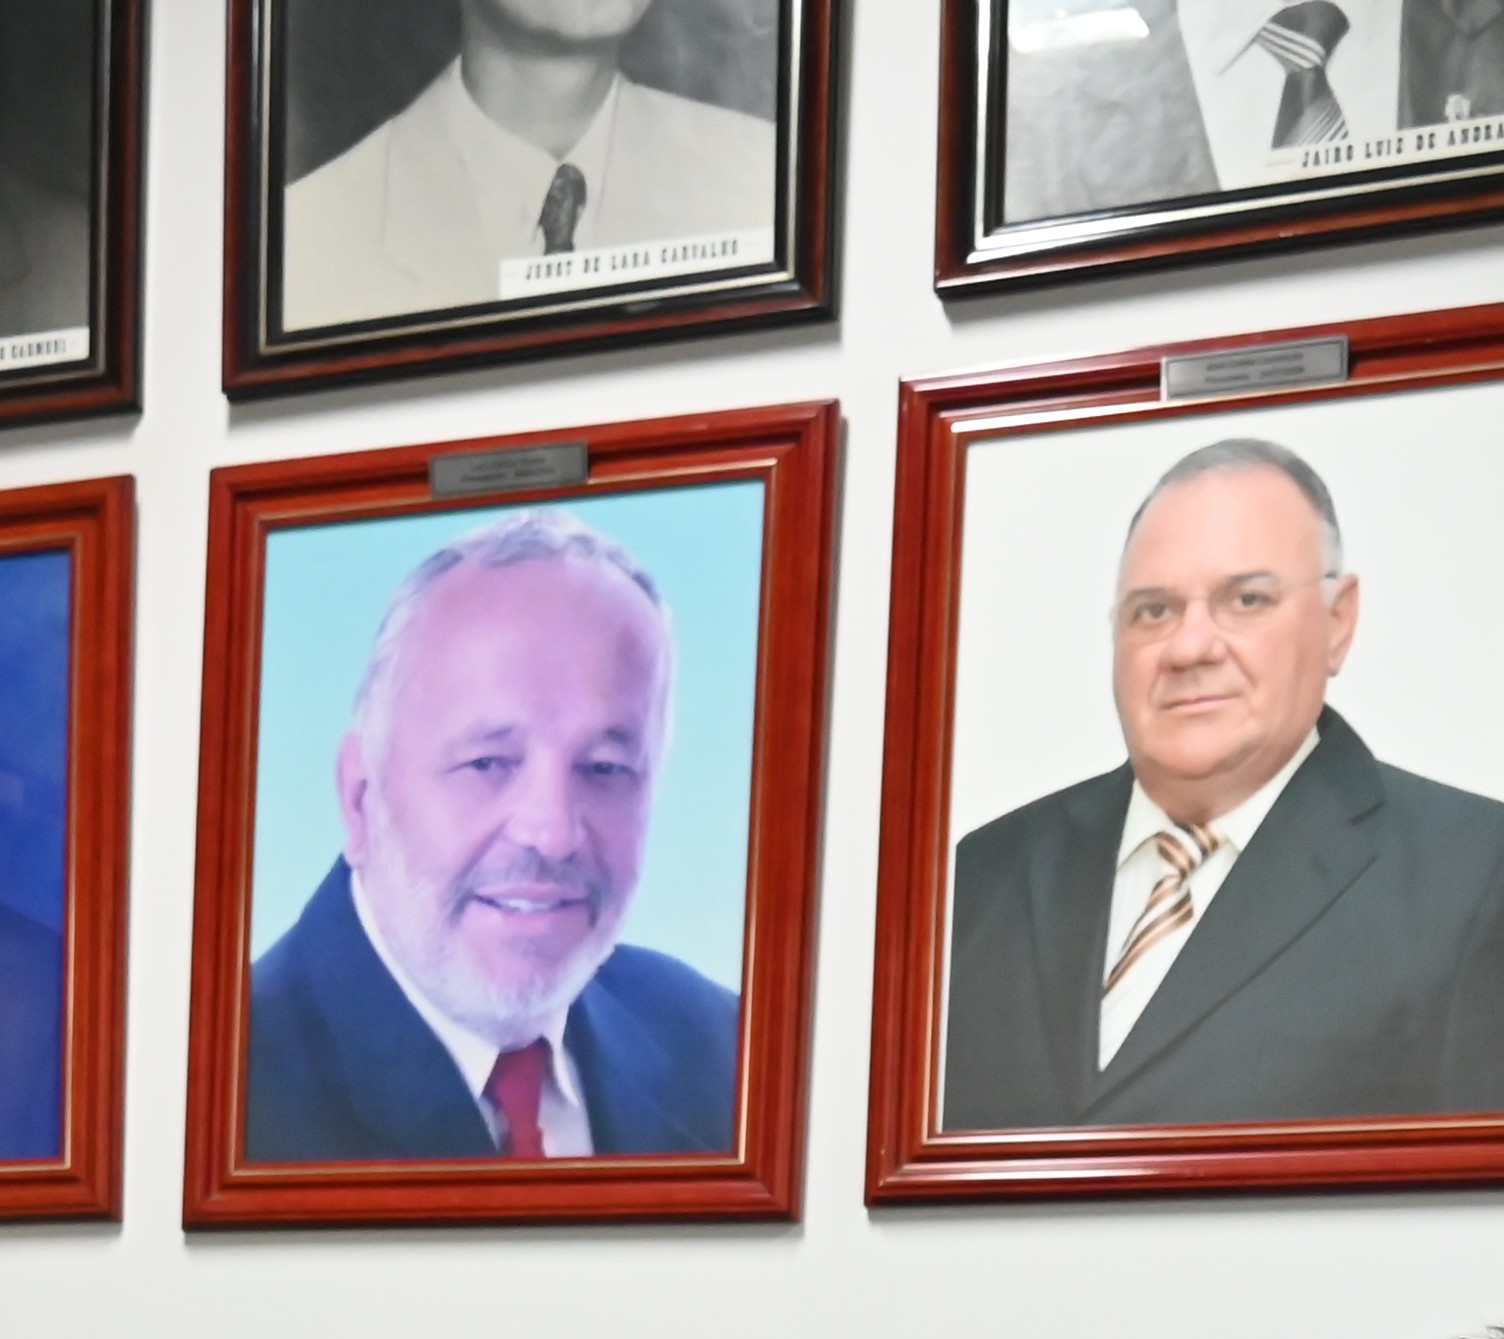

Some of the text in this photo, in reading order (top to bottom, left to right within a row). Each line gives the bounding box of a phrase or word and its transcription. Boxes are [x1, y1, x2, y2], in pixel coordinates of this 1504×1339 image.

[1302, 143, 1353, 167] JAIRO
[1365, 137, 1403, 160] LUIZ
[1416, 133, 1436, 151] DE
[584, 256, 601, 273] DE
[661, 239, 738, 264] CARVALHO
